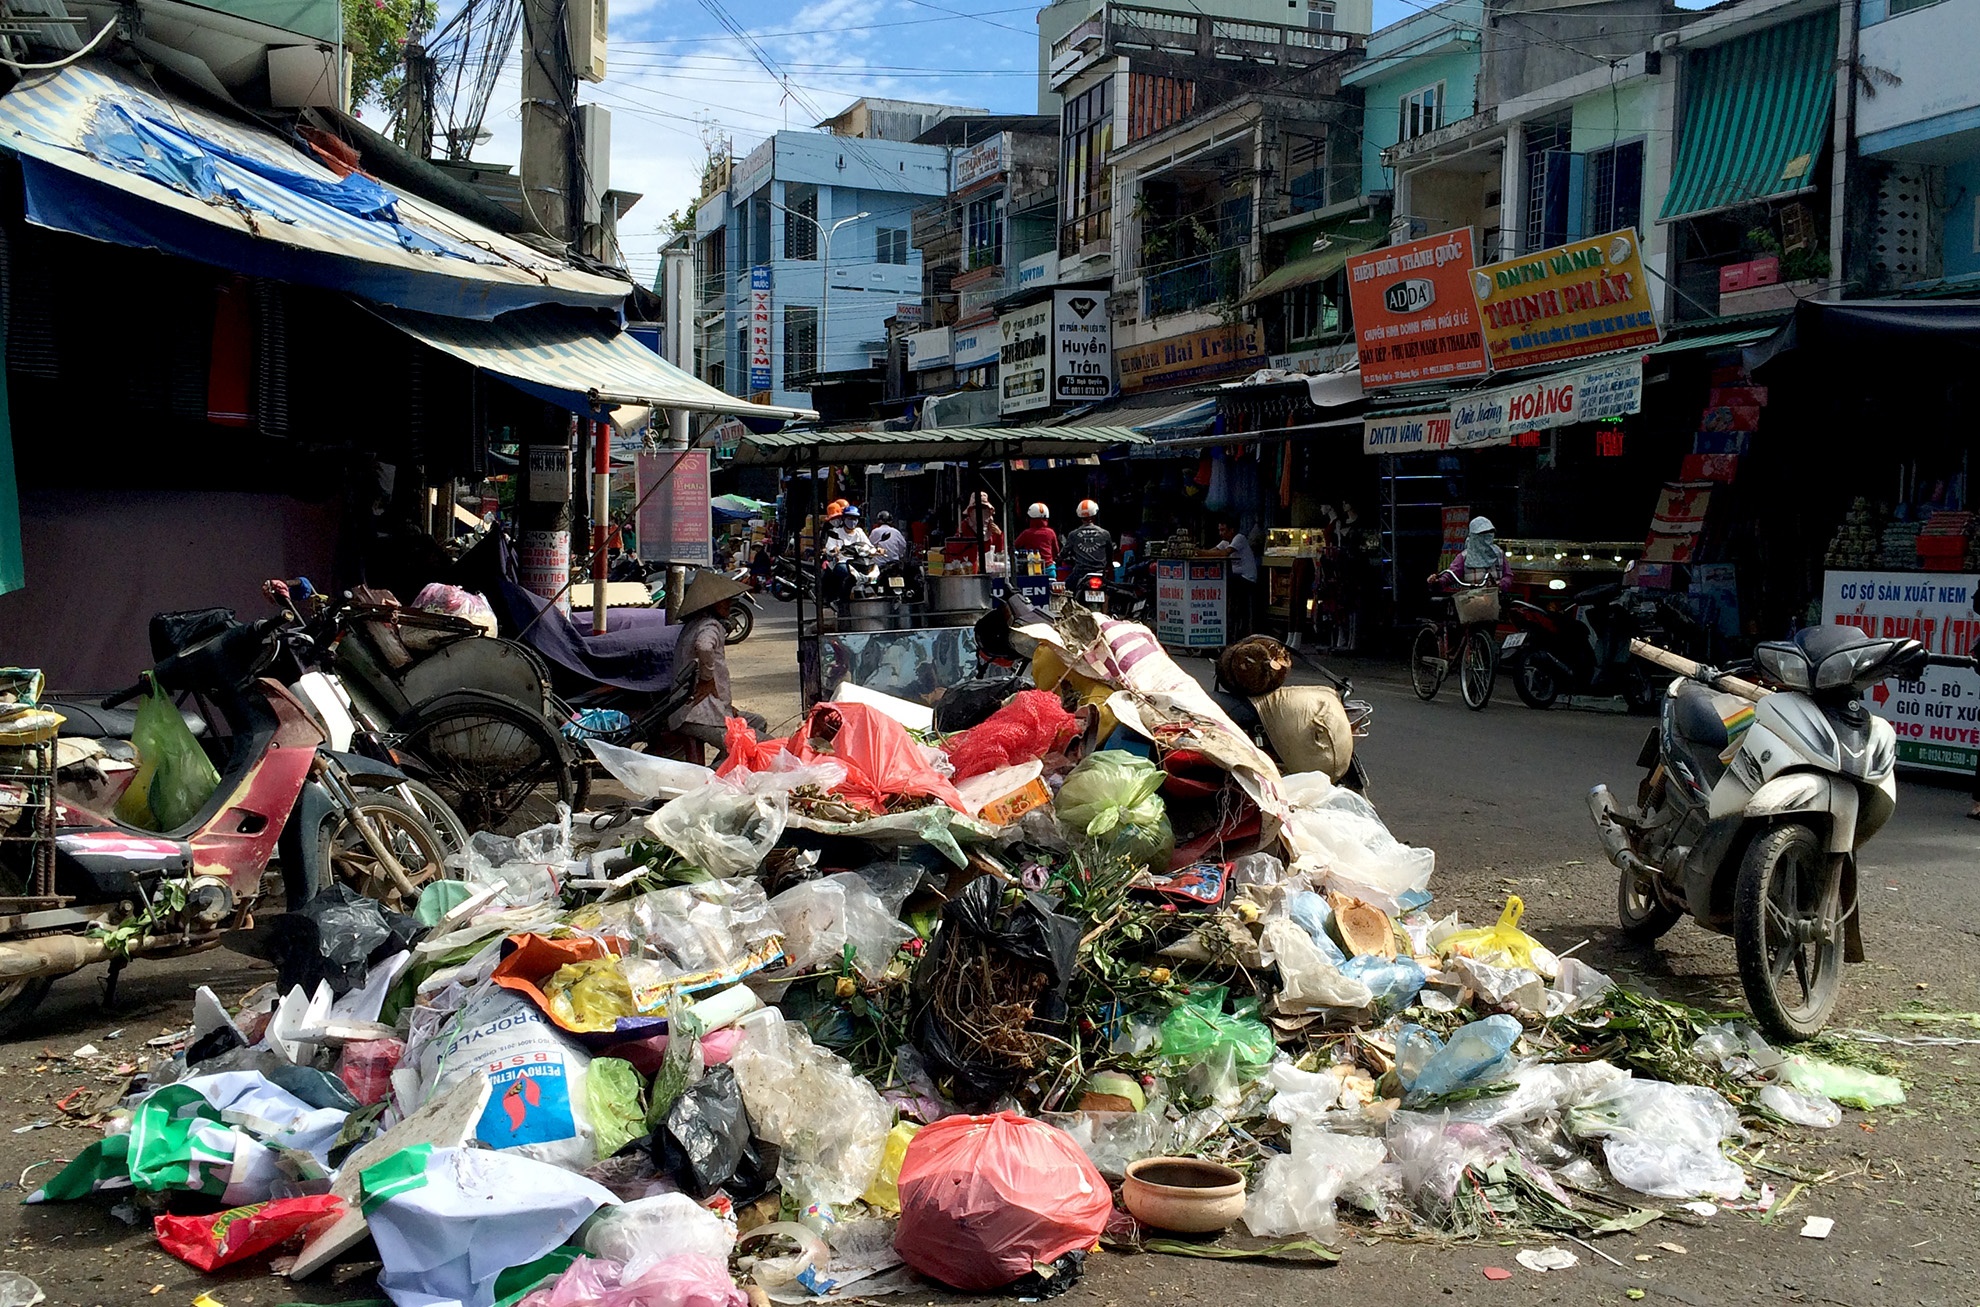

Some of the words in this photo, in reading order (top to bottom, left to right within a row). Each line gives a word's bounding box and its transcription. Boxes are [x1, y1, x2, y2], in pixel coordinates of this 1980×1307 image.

[1550, 246, 1604, 275] VÀNG
[1389, 286, 1427, 309] ADDA
[1484, 288, 1559, 331] THỊNH
[1562, 268, 1632, 313] PHÁT
[1062, 336, 1106, 356] Huyền
[1445, 332, 1481, 354] THAILAND
[1069, 360, 1101, 374] Trân
[1508, 384, 1574, 422] HOÀNG
[1369, 427, 1397, 446] DNTN
[1398, 419, 1423, 443] VÀNG
[1841, 582, 1857, 600] CƠ
[1860, 580, 1875, 601] SỞ
[1878, 581, 1901, 602] SẢN
[1904, 580, 1935, 603] XUẤT
[1939, 588, 1967, 604] NEM
[1898, 681, 1926, 695] HEO
[1942, 681, 1961, 699] BÒ
[1897, 699, 1919, 716] GIÒ
[1925, 700, 1953, 719] RÚT
